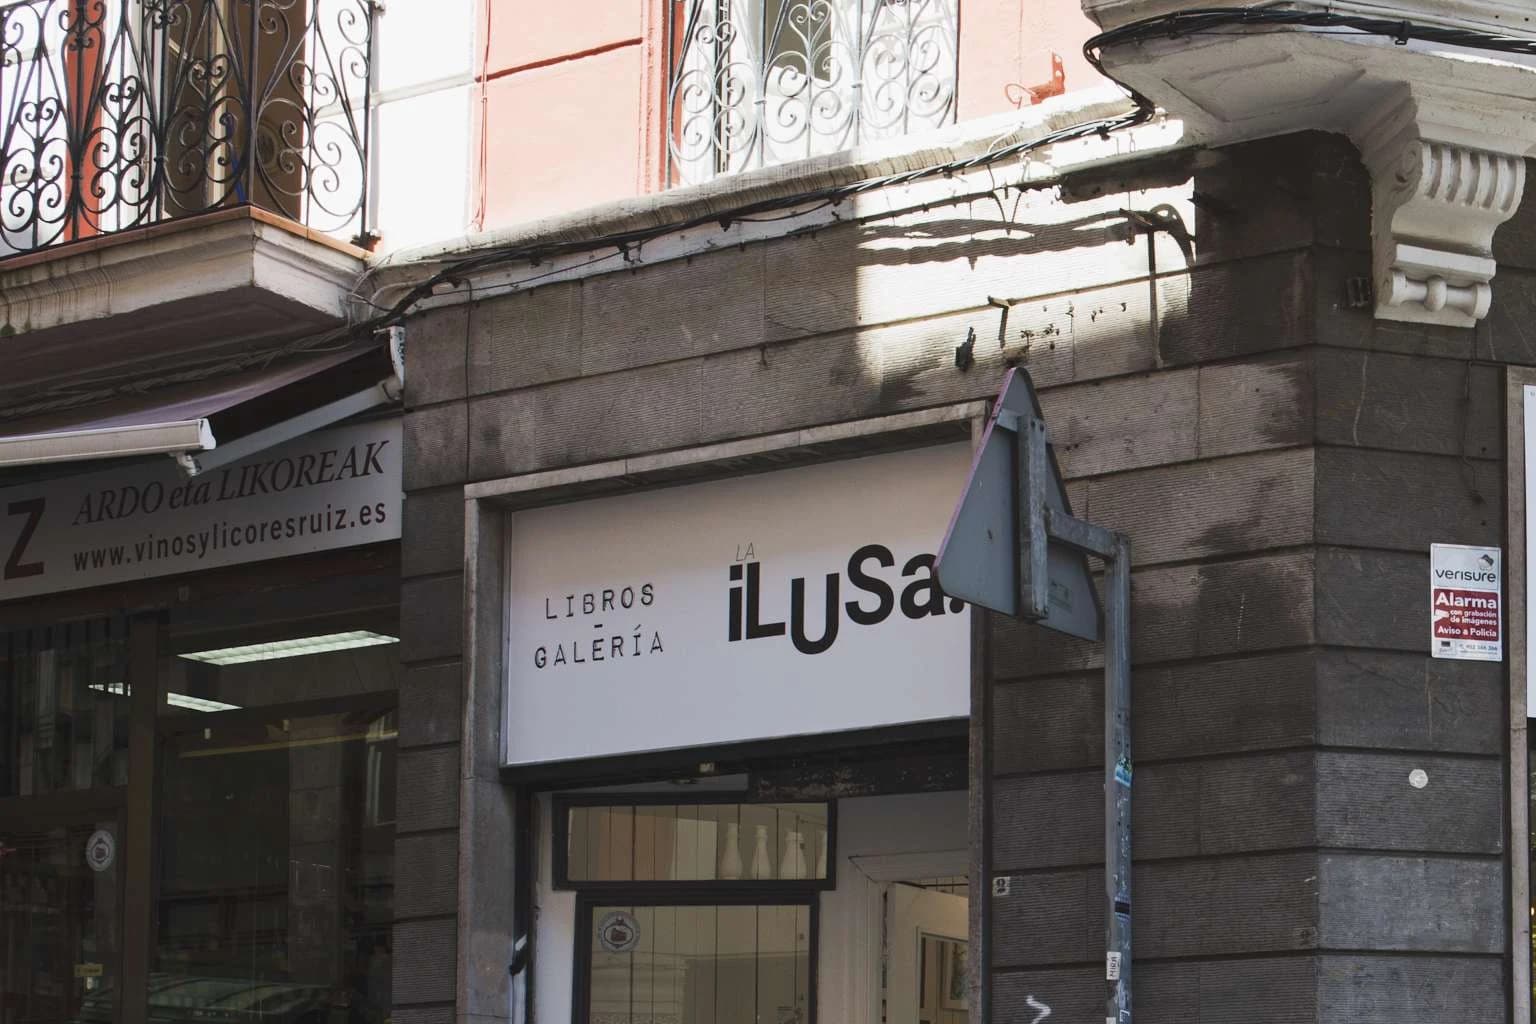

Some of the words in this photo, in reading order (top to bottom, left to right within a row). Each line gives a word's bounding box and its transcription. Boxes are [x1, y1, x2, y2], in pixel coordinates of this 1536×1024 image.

[72, 480, 164, 526] ARDO
[169, 478, 211, 510] eta
[216, 440, 390, 502] LIKOREAK
[73, 501, 387, 572] www.vinosylicoresruiz.es
[735, 542, 756, 562] LA
[1435, 569, 1496, 582] verisure
[545, 583, 655, 621] LIBROS
[1435, 592, 1497, 610] Alarma
[1450, 616, 1460, 624] de
[1437, 625, 1461, 636] Aviso
[534, 623, 665, 670] GALERÍA
